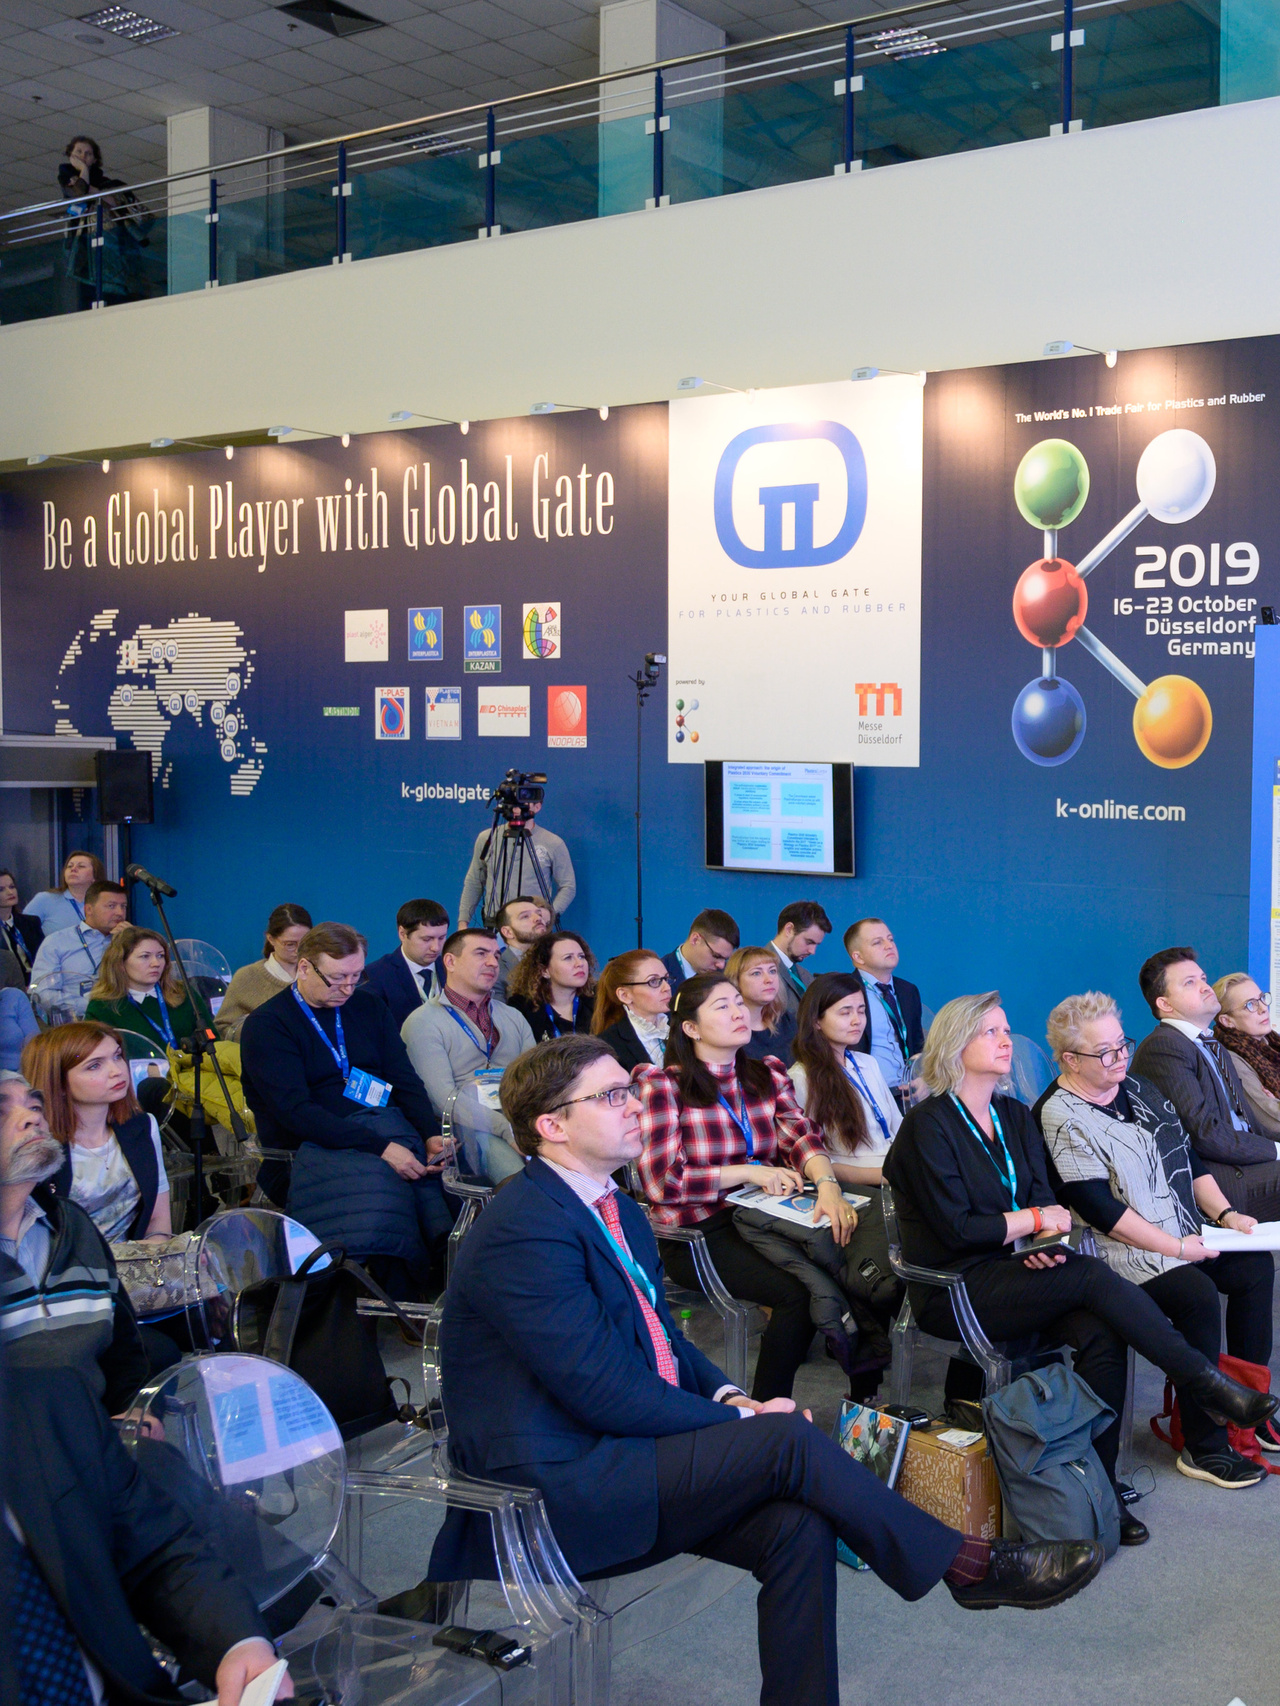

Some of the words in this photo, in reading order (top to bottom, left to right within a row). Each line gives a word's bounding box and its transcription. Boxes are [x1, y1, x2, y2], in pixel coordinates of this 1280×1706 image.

[1015, 413, 1032, 424] The
[1072, 408, 1088, 419] No.
[1096, 405, 1122, 416] Trade
[1124, 403, 1144, 414] Fair
[1147, 401, 1162, 412] for
[1164, 398, 1204, 410] Plastics
[1207, 395, 1226, 406] and
[1229, 392, 1266, 404] Rubber
[42, 500, 72, 571] Be
[83, 515, 98, 568] a
[107, 484, 199, 570] Global
[208, 480, 304, 573] Player
[316, 467, 390, 552] with
[402, 454, 518, 551] Global
[532, 451, 615, 543] Gate
[1134, 541, 1260, 589] 2019
[711, 592, 749, 602] YOUR
[760, 590, 820, 600] GLOBAL
[831, 588, 870, 598] GATE
[679, 610, 706, 618] FOR
[716, 606, 790, 618] PLASTICS
[801, 605, 831, 615] AND
[842, 602, 906, 614] RUBBER
[1113, 596, 1174, 616] 16-23
[1178, 594, 1258, 614] October
[1146, 616, 1257, 636] Düsseldorf
[1168, 638, 1256, 659] Germany
[470, 662, 496, 671] KAZAN
[676, 678, 697, 686] powered
[698, 678, 705, 686] by
[380, 689, 404, 697] T-PLAS
[497, 705, 527, 713] Chinaplas
[428, 720, 459, 728] VIETNAM
[858, 721, 883, 731] Messe
[548, 738, 586, 746] INDOPLAS
[858, 734, 902, 744] Düsseldorf
[1056, 798, 1186, 822] k-online.com
